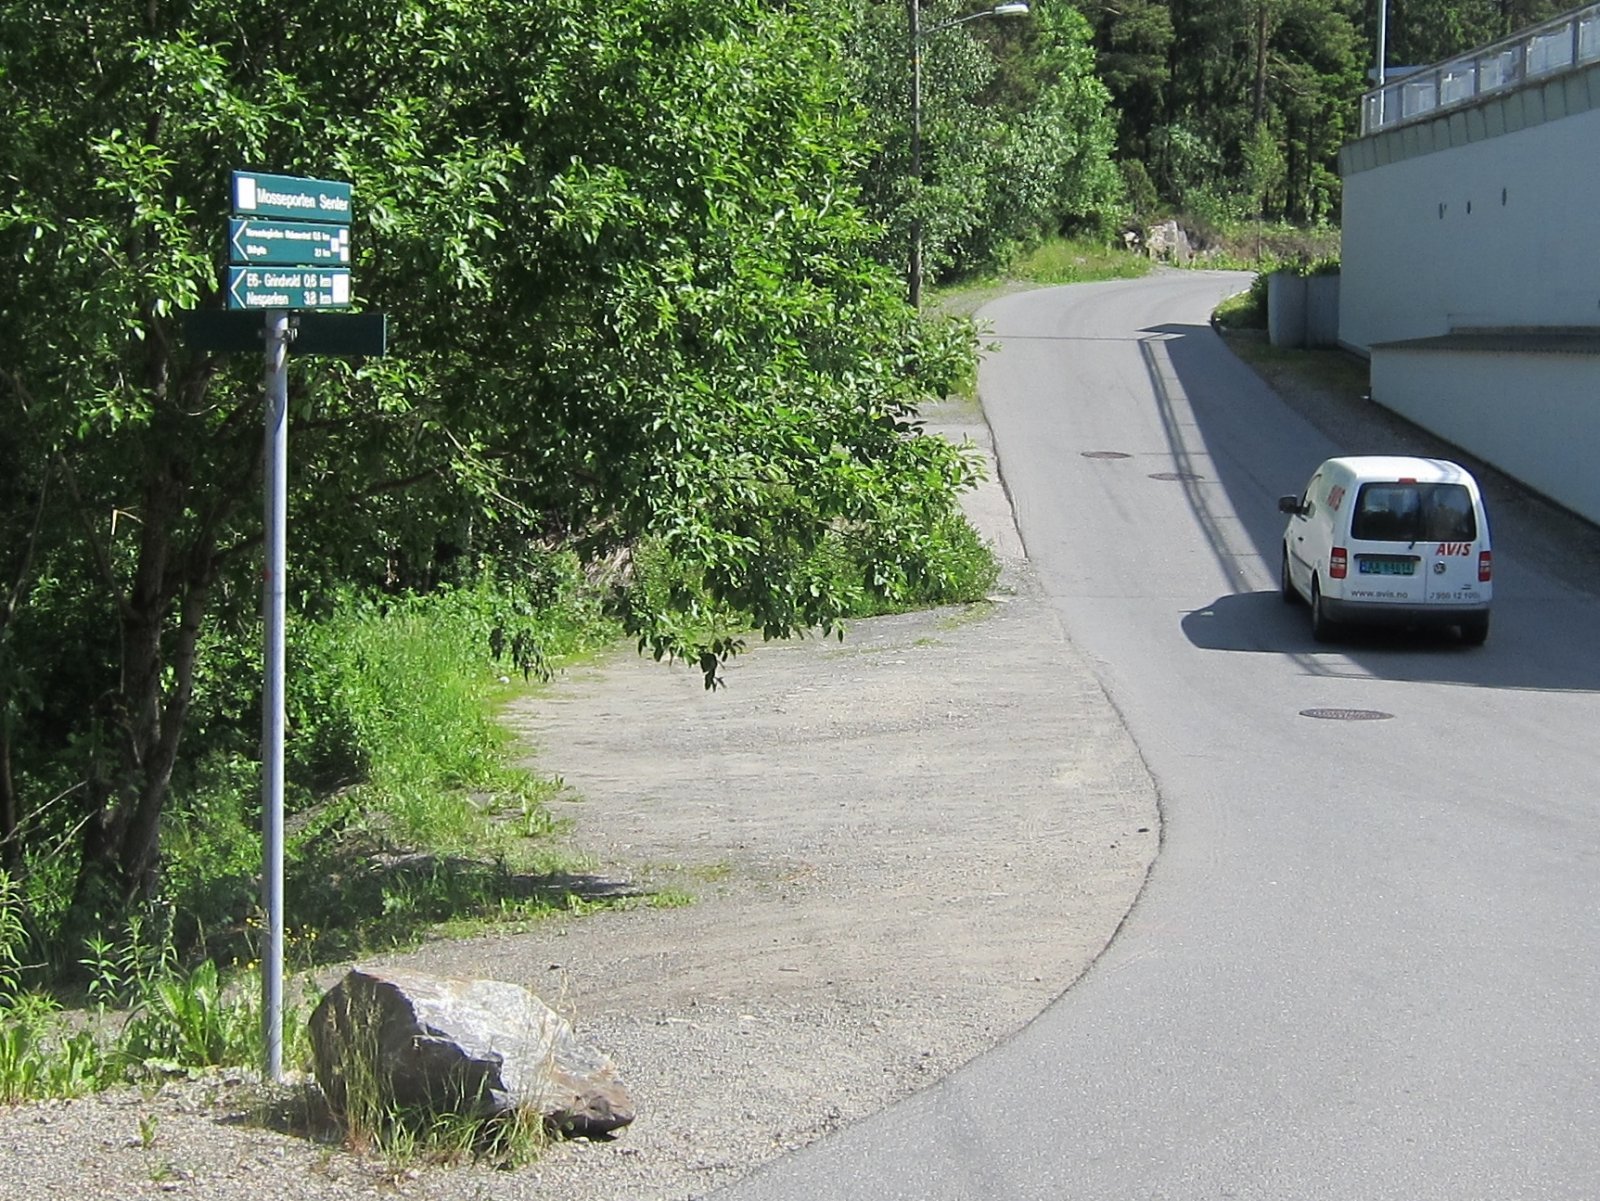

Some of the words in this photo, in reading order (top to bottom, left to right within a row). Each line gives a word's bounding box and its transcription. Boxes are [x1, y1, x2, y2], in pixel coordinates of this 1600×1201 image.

[257, 187, 316, 209] Mosseporten
[319, 193, 348, 211] Senter
[319, 274, 332, 288] km
[246, 292, 289, 308] Nesparken
[319, 292, 332, 305] km
[1435, 543, 1472, 557] AVIS
[1351, 590, 1409, 599] www.avis.no
